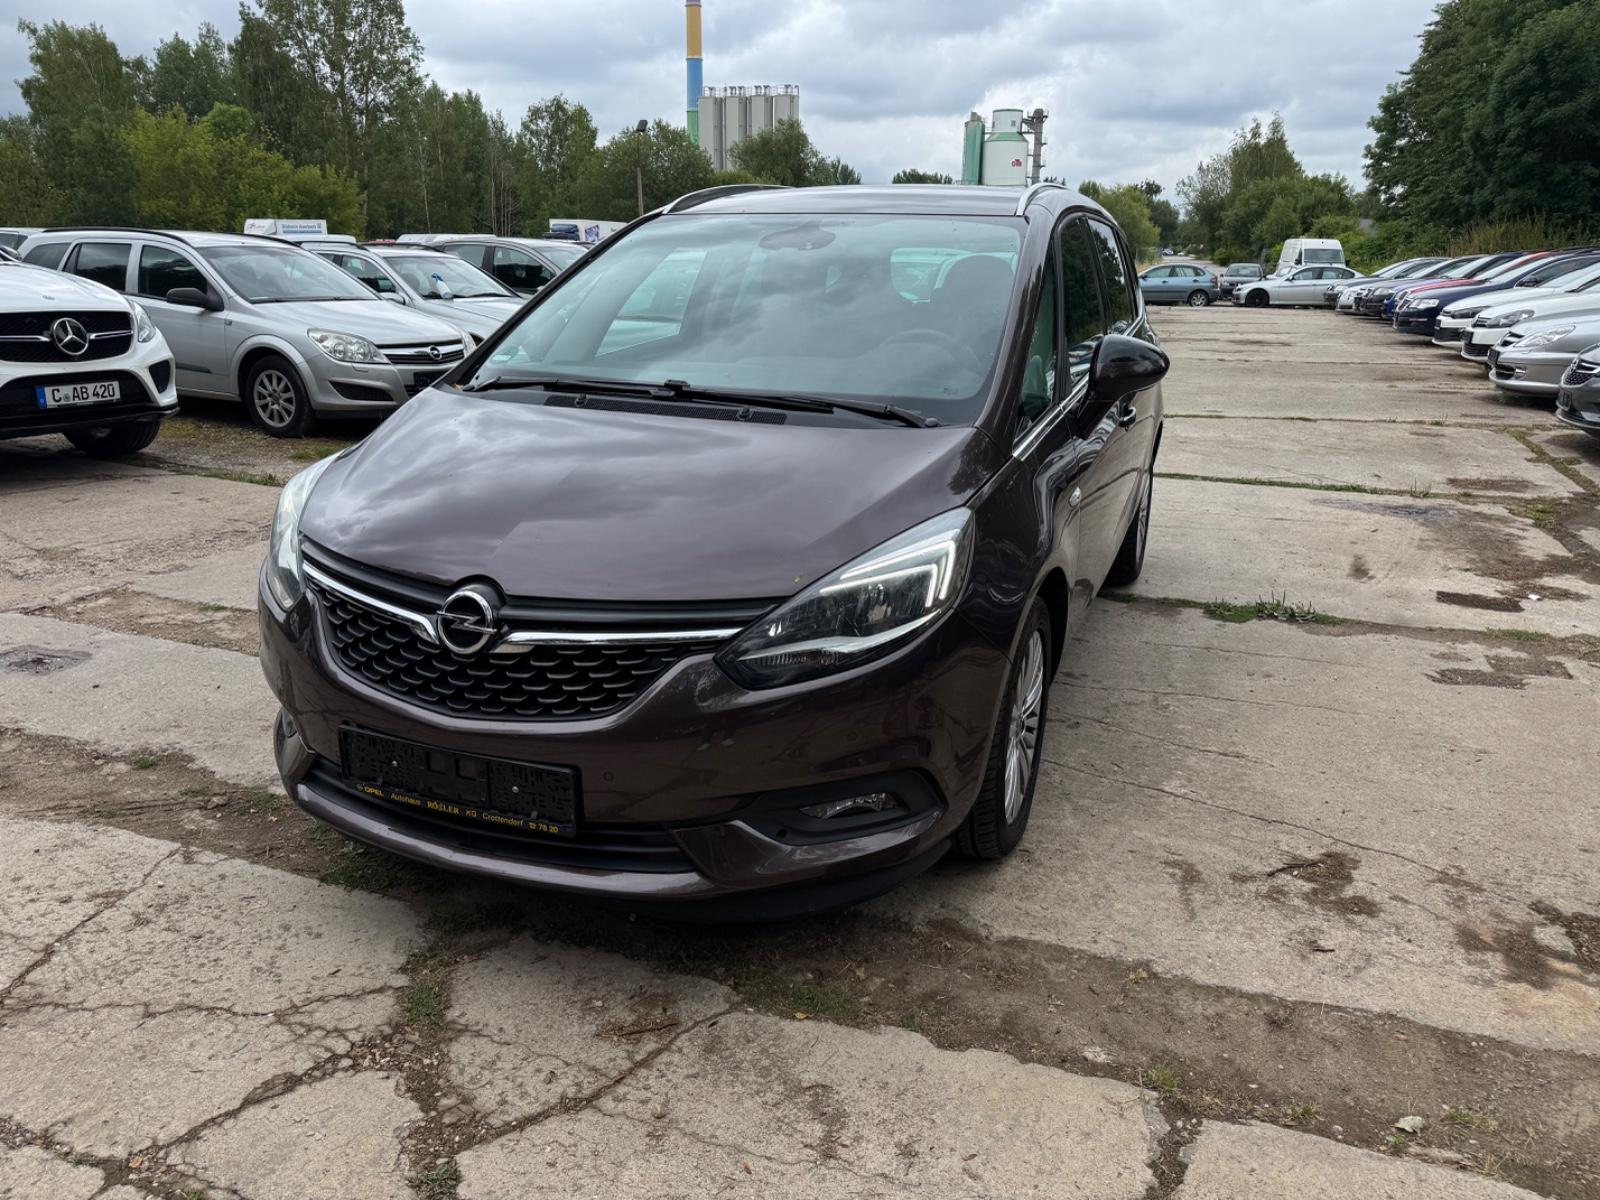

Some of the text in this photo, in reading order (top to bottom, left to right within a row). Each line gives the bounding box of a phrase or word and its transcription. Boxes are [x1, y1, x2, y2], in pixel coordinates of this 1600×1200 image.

[51, 383, 116, 403] C AB 420
[364, 785, 384, 798] OPEL
[390, 792, 421, 806] Autohaus
